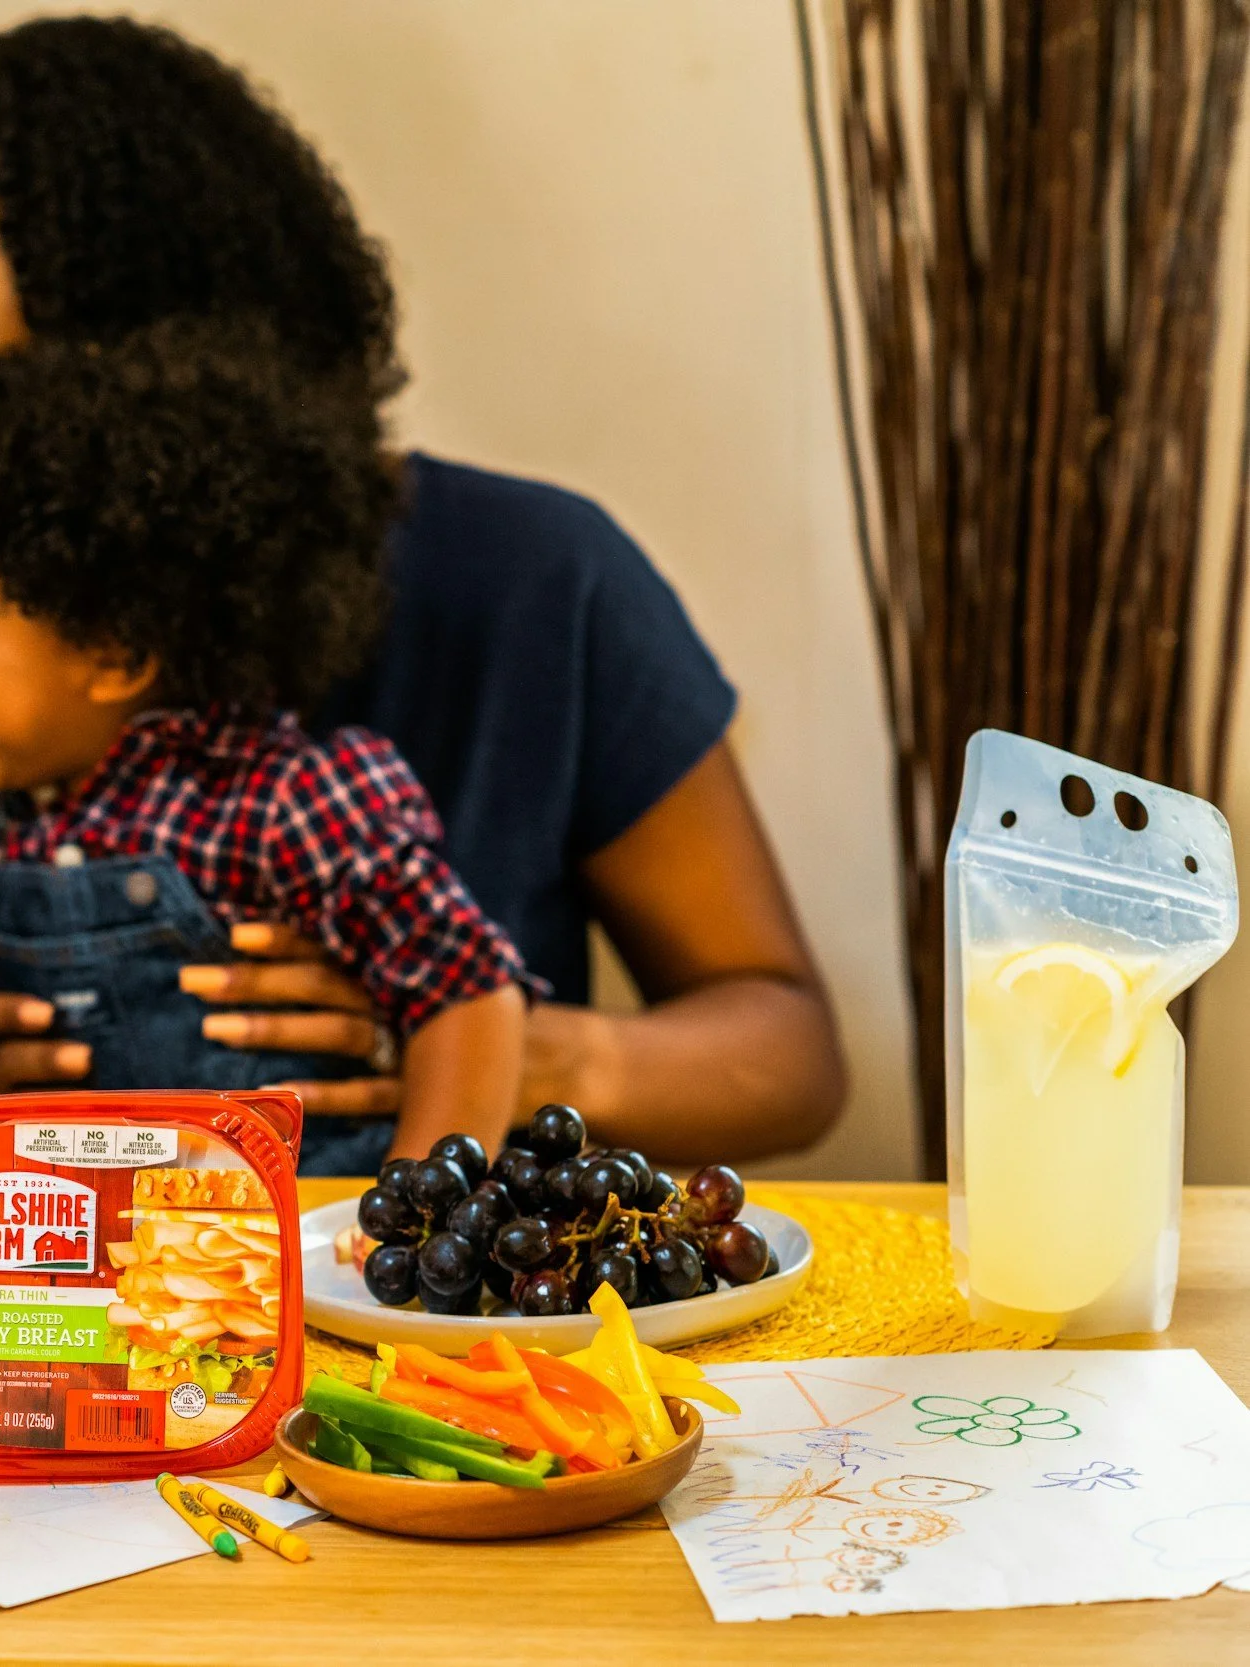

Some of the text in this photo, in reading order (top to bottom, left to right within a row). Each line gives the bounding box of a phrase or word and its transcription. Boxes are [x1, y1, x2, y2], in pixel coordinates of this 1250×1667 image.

[39, 1130, 56, 1138] NO
[87, 1131, 104, 1140] NO
[137, 1132, 154, 1141] NO
[20, 1290, 48, 1301] THIN
[2, 1312, 63, 1325] ROASTED
[17, 1328, 98, 1347] BREAST
[173, 1385, 204, 1400] INSPECTED
[4, 1412, 10, 1426] 9
[12, 1413, 24, 1427] OZ
[26, 1413, 54, 1430] (255g)
[218, 1503, 260, 1536] CRAYONS
